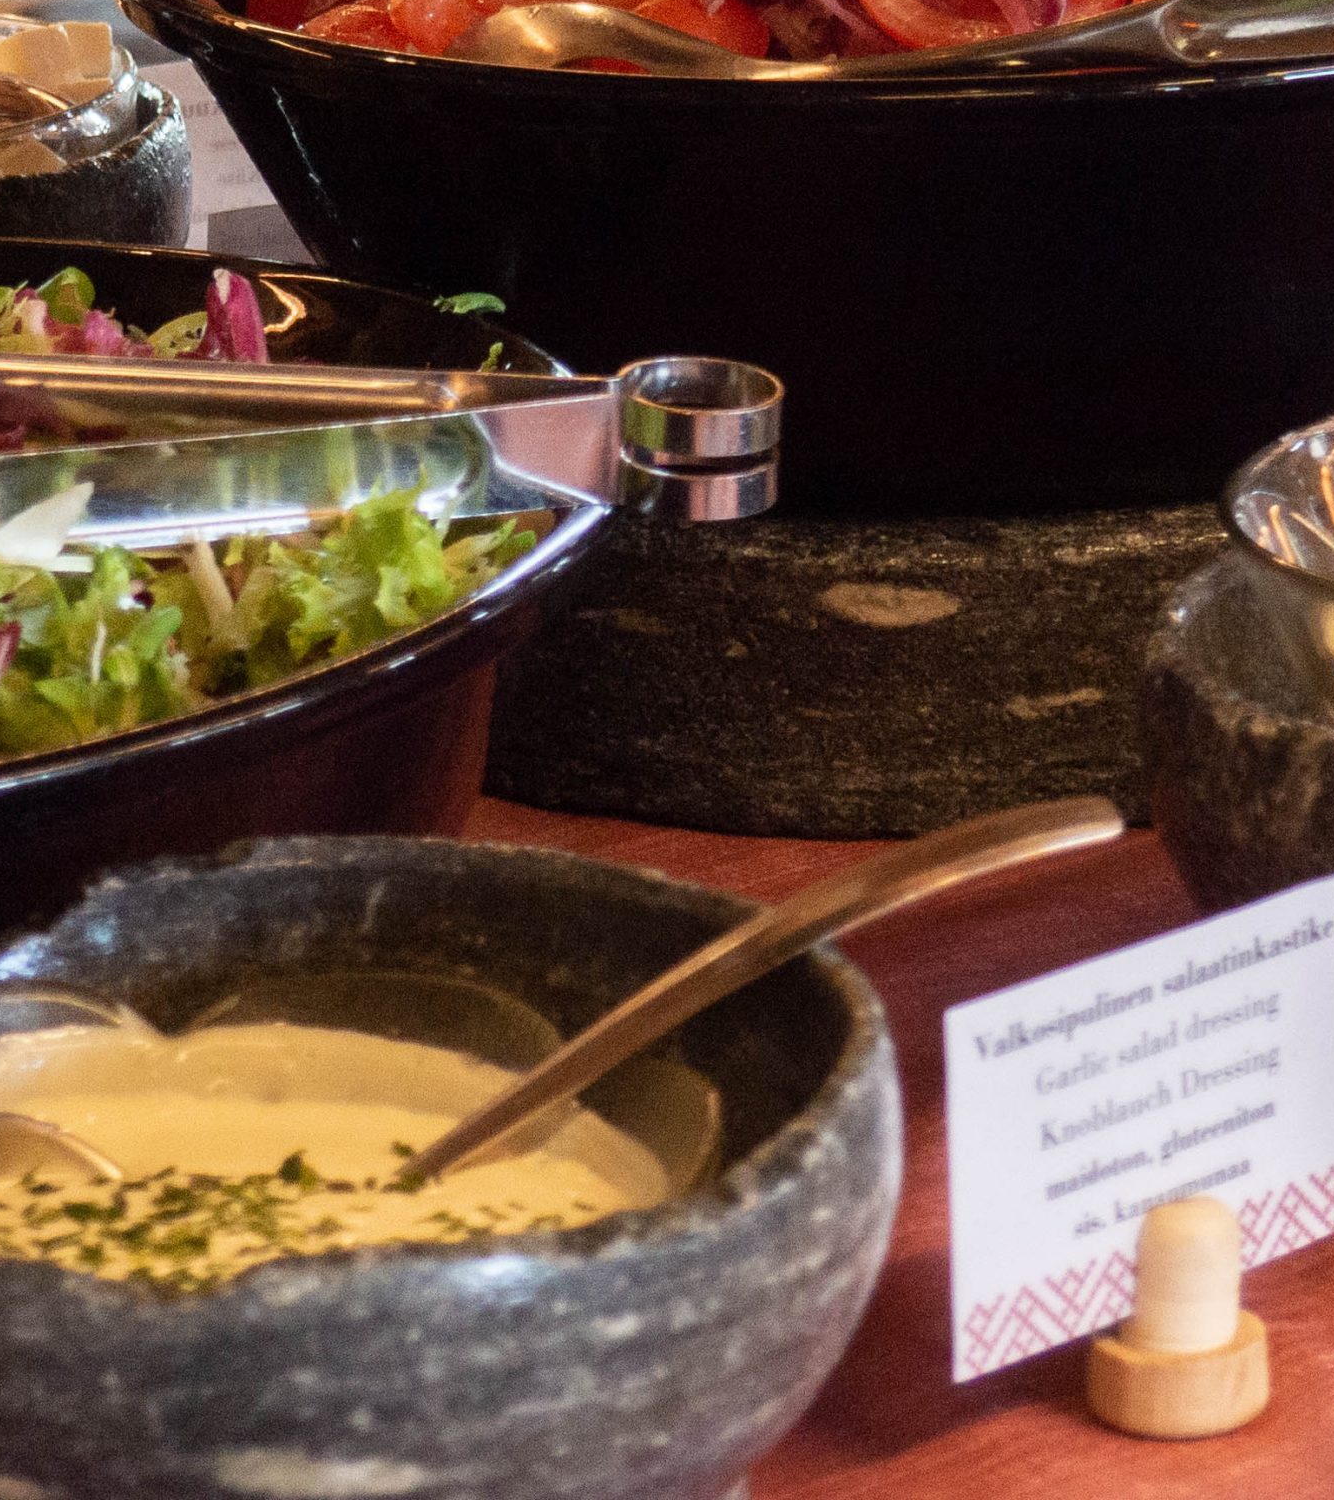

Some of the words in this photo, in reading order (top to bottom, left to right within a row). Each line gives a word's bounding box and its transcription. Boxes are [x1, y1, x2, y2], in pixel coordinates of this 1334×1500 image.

[1161, 916, 1334, 998] salaatinkastike
[1034, 1050, 1109, 1096] Garlic
[1117, 1020, 1179, 1066] salad
[1185, 991, 1281, 1042] dressing
[1180, 1046, 1281, 1099] Dressing
